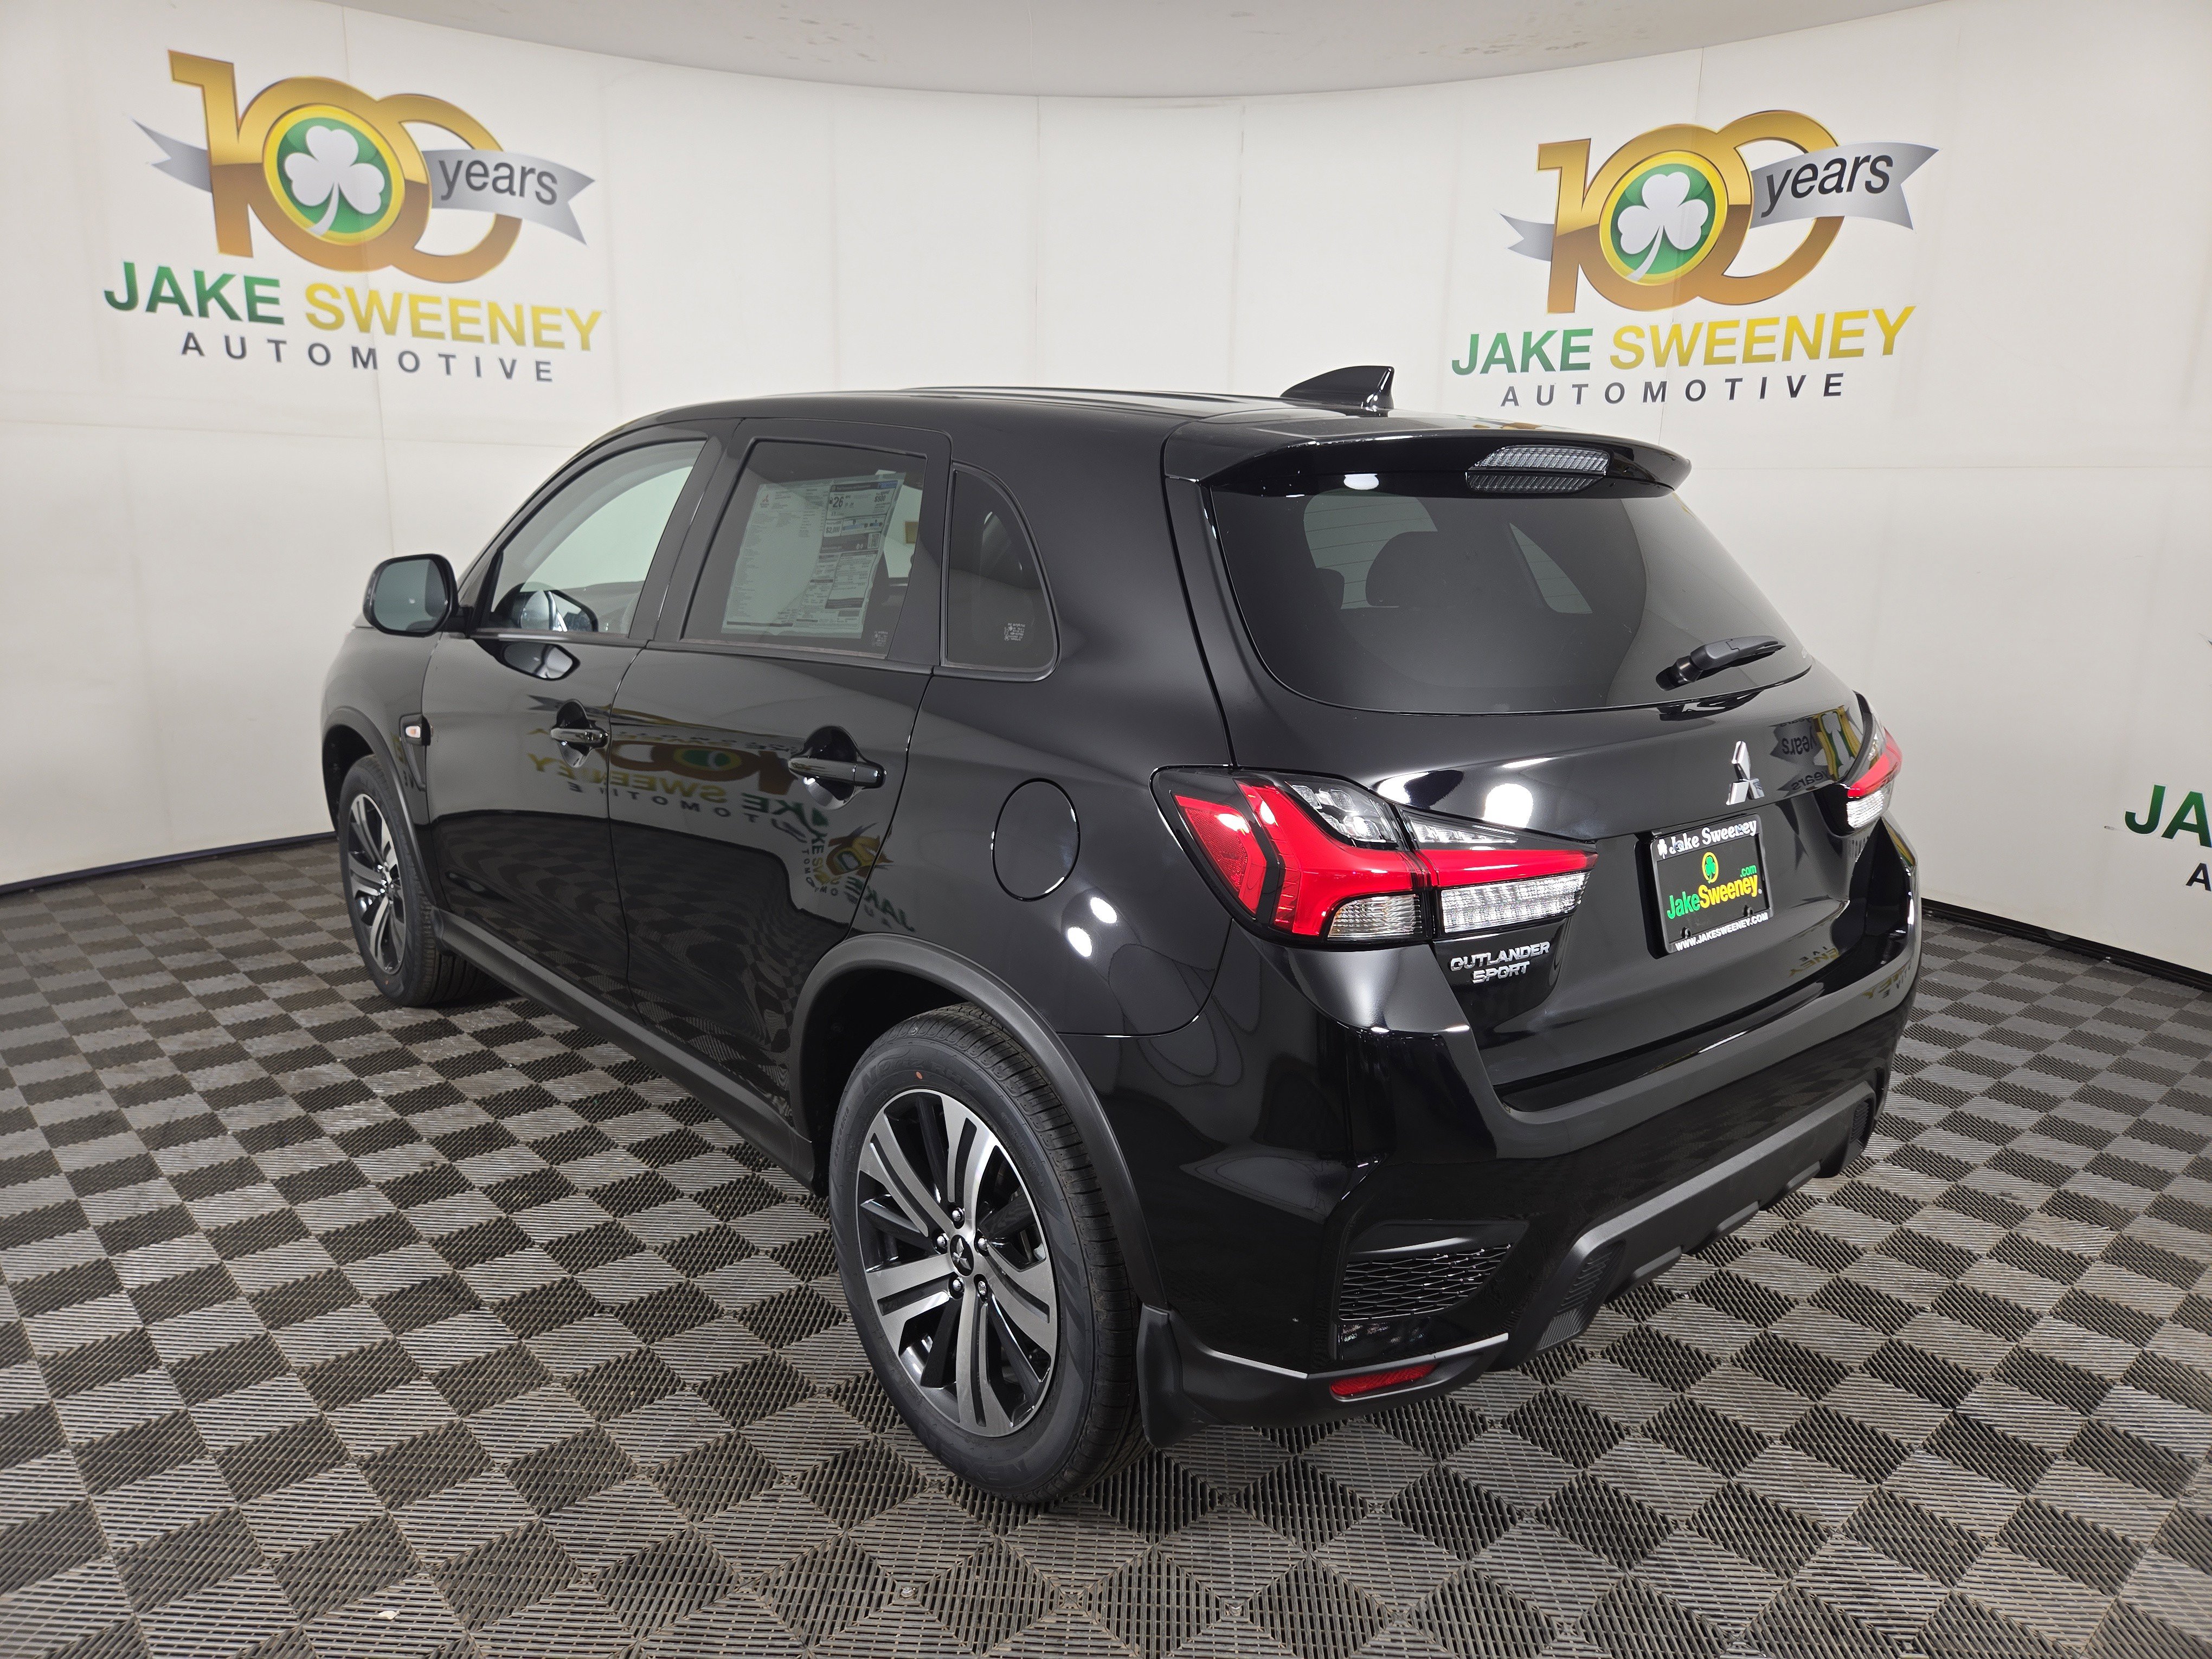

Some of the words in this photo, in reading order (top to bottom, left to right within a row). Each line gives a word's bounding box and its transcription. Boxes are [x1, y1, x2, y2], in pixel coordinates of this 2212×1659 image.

[168, 49, 522, 283] 100
[439, 157, 558, 205] years
[1536, 110, 1844, 313] 100
[1760, 153, 1894, 217] years
[104, 261, 285, 326] JAKE
[305, 282, 602, 352] SWEENEY
[181, 331, 553, 382] AUTOMOTIVE
[1451, 327, 1594, 376] JAKE
[1610, 305, 1917, 370] SWEENEY
[1501, 372, 1844, 407] AUTOMOTIVE
[1669, 833, 1700, 854] Jake
[1702, 820, 1757, 845] Sweeney
[1675, 912, 1769, 951] WWW.JAKESWEENEY.COM
[1450, 941, 1551, 972] OUTLANDER
[1472, 961, 1530, 984] SPORT
